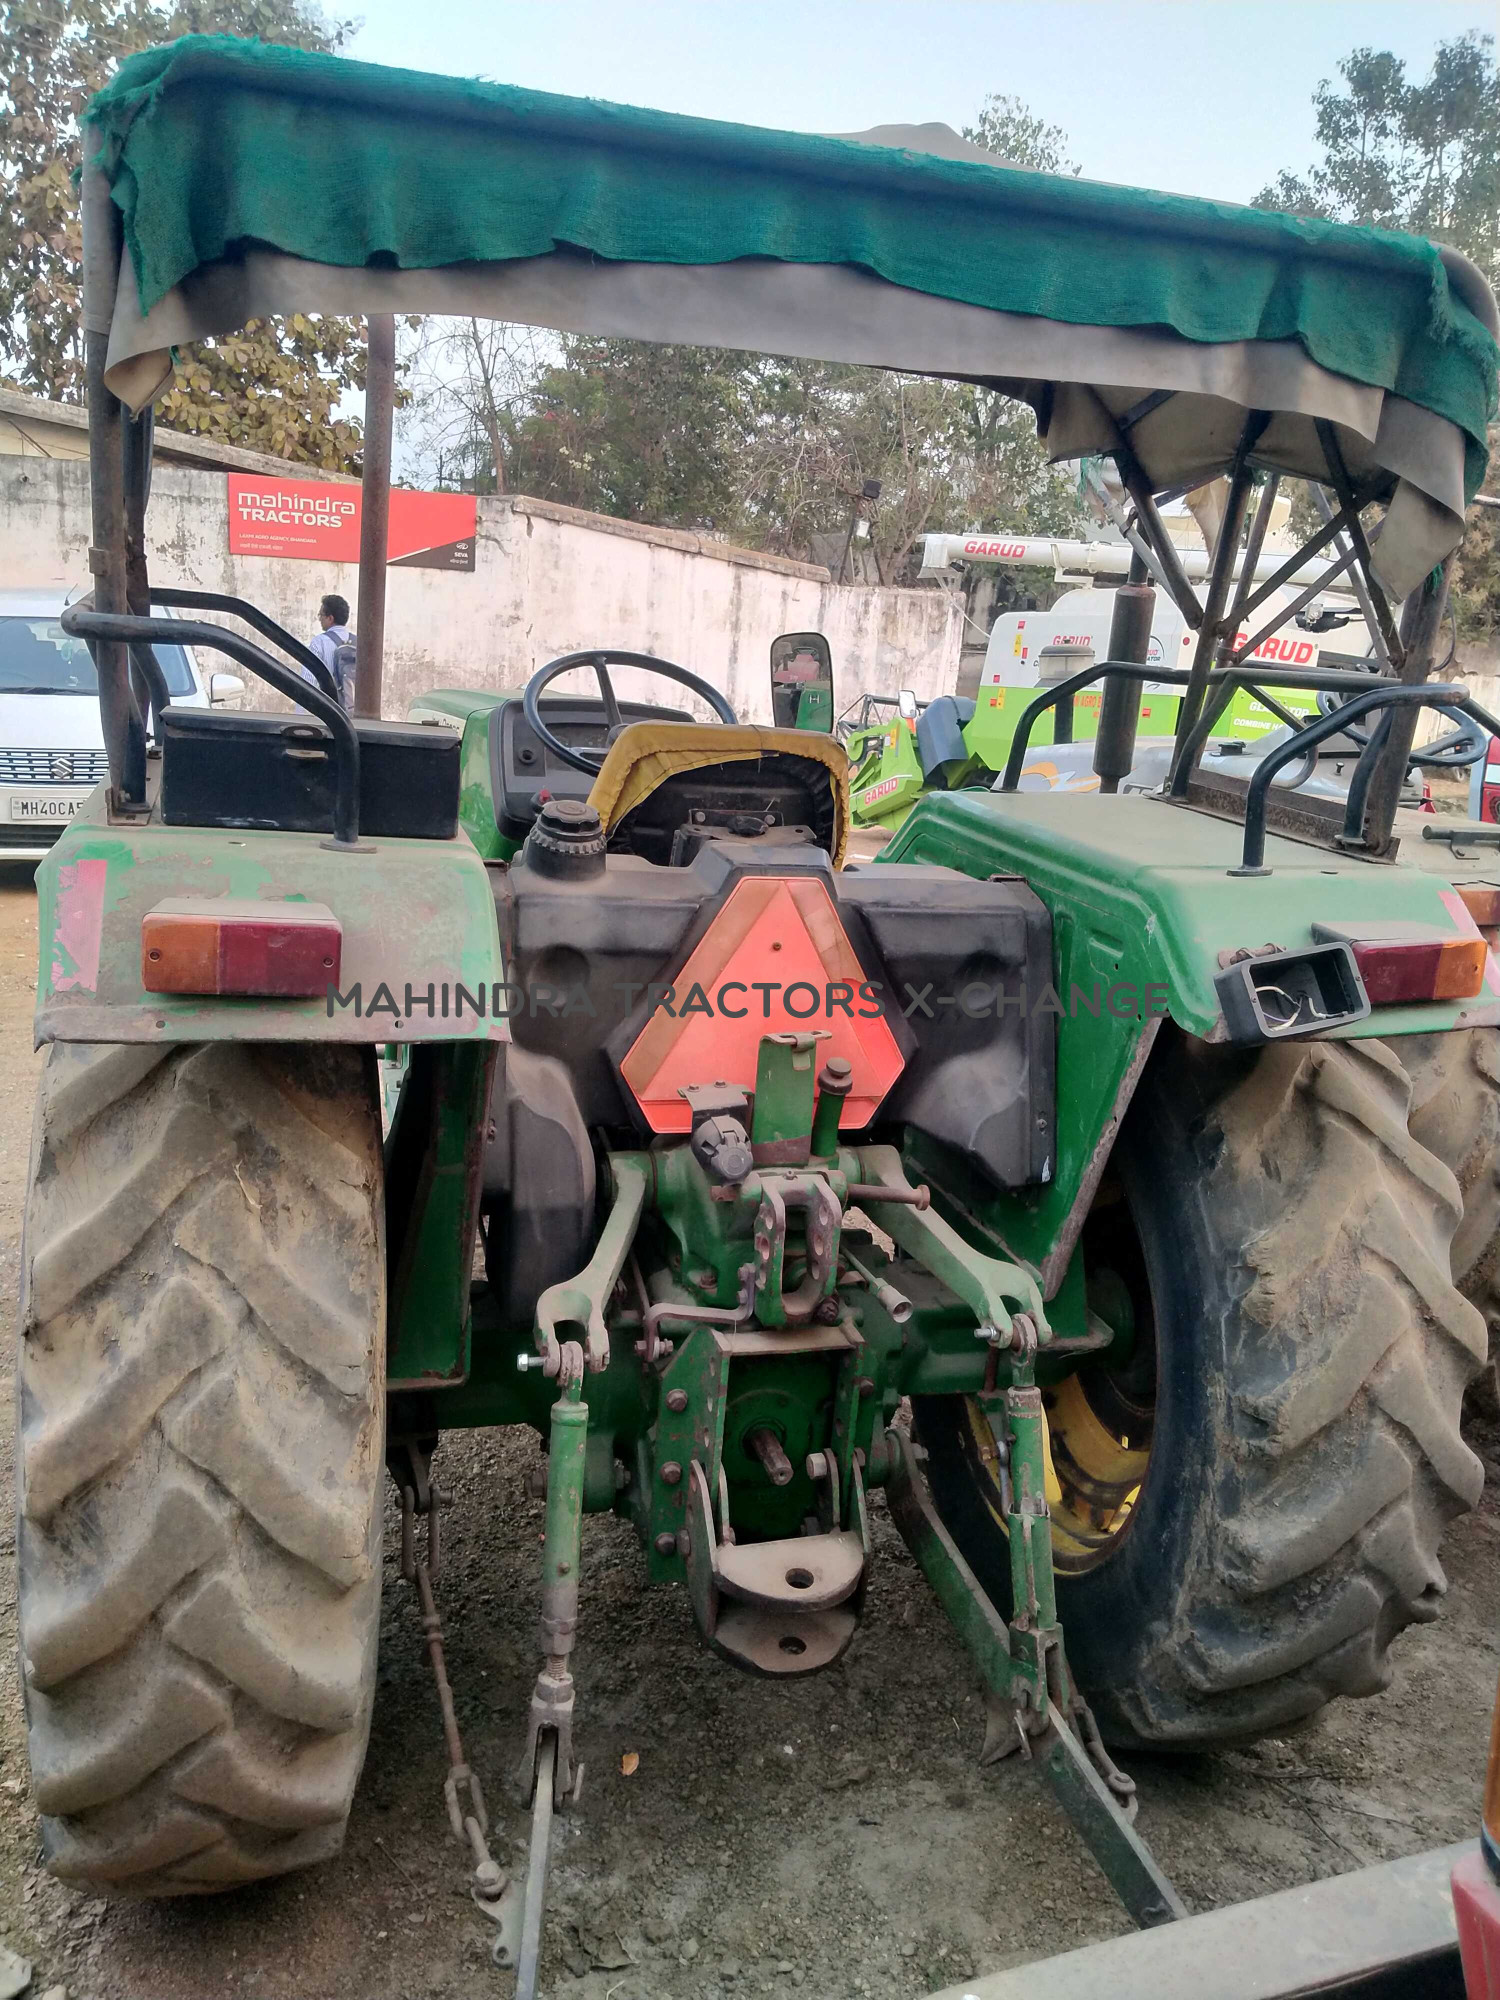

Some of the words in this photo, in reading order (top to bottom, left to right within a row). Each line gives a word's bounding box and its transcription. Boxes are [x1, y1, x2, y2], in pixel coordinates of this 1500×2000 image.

[238, 492, 356, 515] mahindra
[239, 507, 343, 528] TRACTORS
[964, 540, 1026, 558] GARUD
[1233, 718, 1271, 730] COMBINE
[864, 777, 899, 806] GARUD
